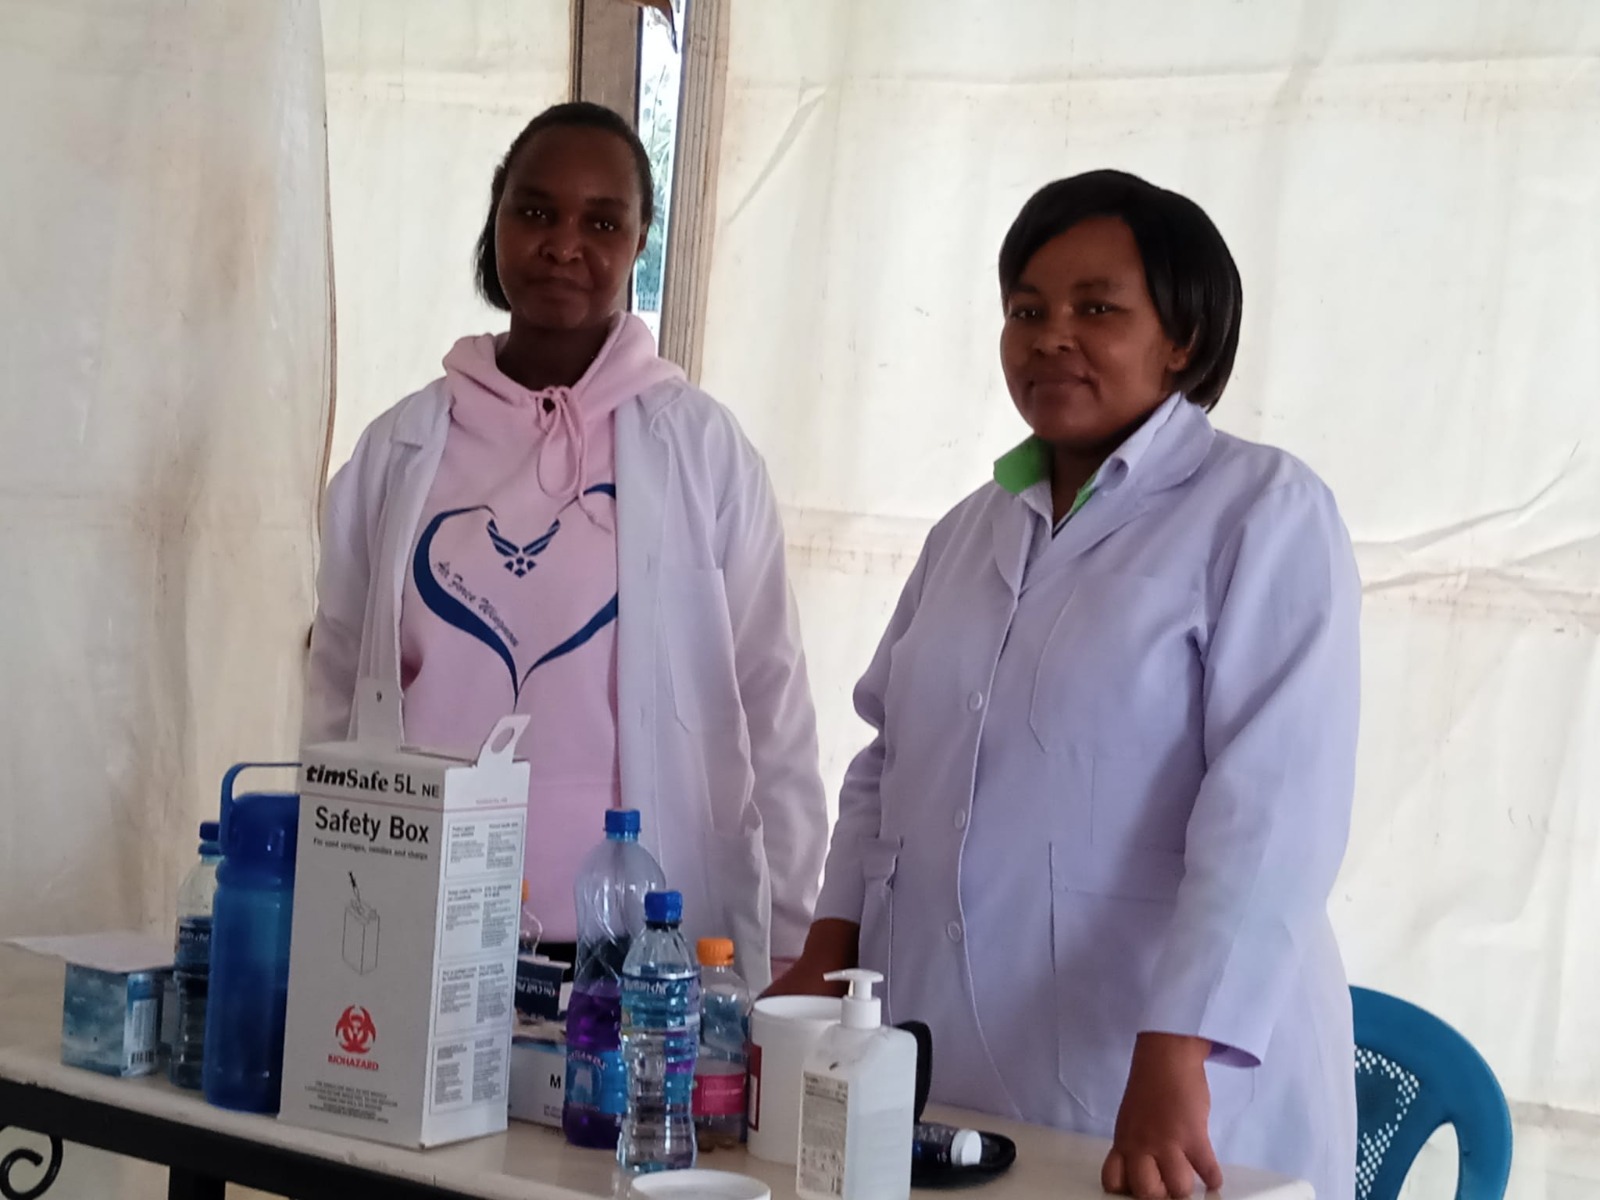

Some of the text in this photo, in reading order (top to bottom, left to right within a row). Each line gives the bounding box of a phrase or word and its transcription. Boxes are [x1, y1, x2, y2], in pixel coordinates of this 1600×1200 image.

[448, 573, 476, 602] Force
[306, 764, 440, 798] timSafe 5L NE
[315, 806, 381, 842] Safety
[389, 815, 430, 844] Box
[327, 1054, 380, 1071] BIOHAZARD
[549, 1073, 561, 1089] M
